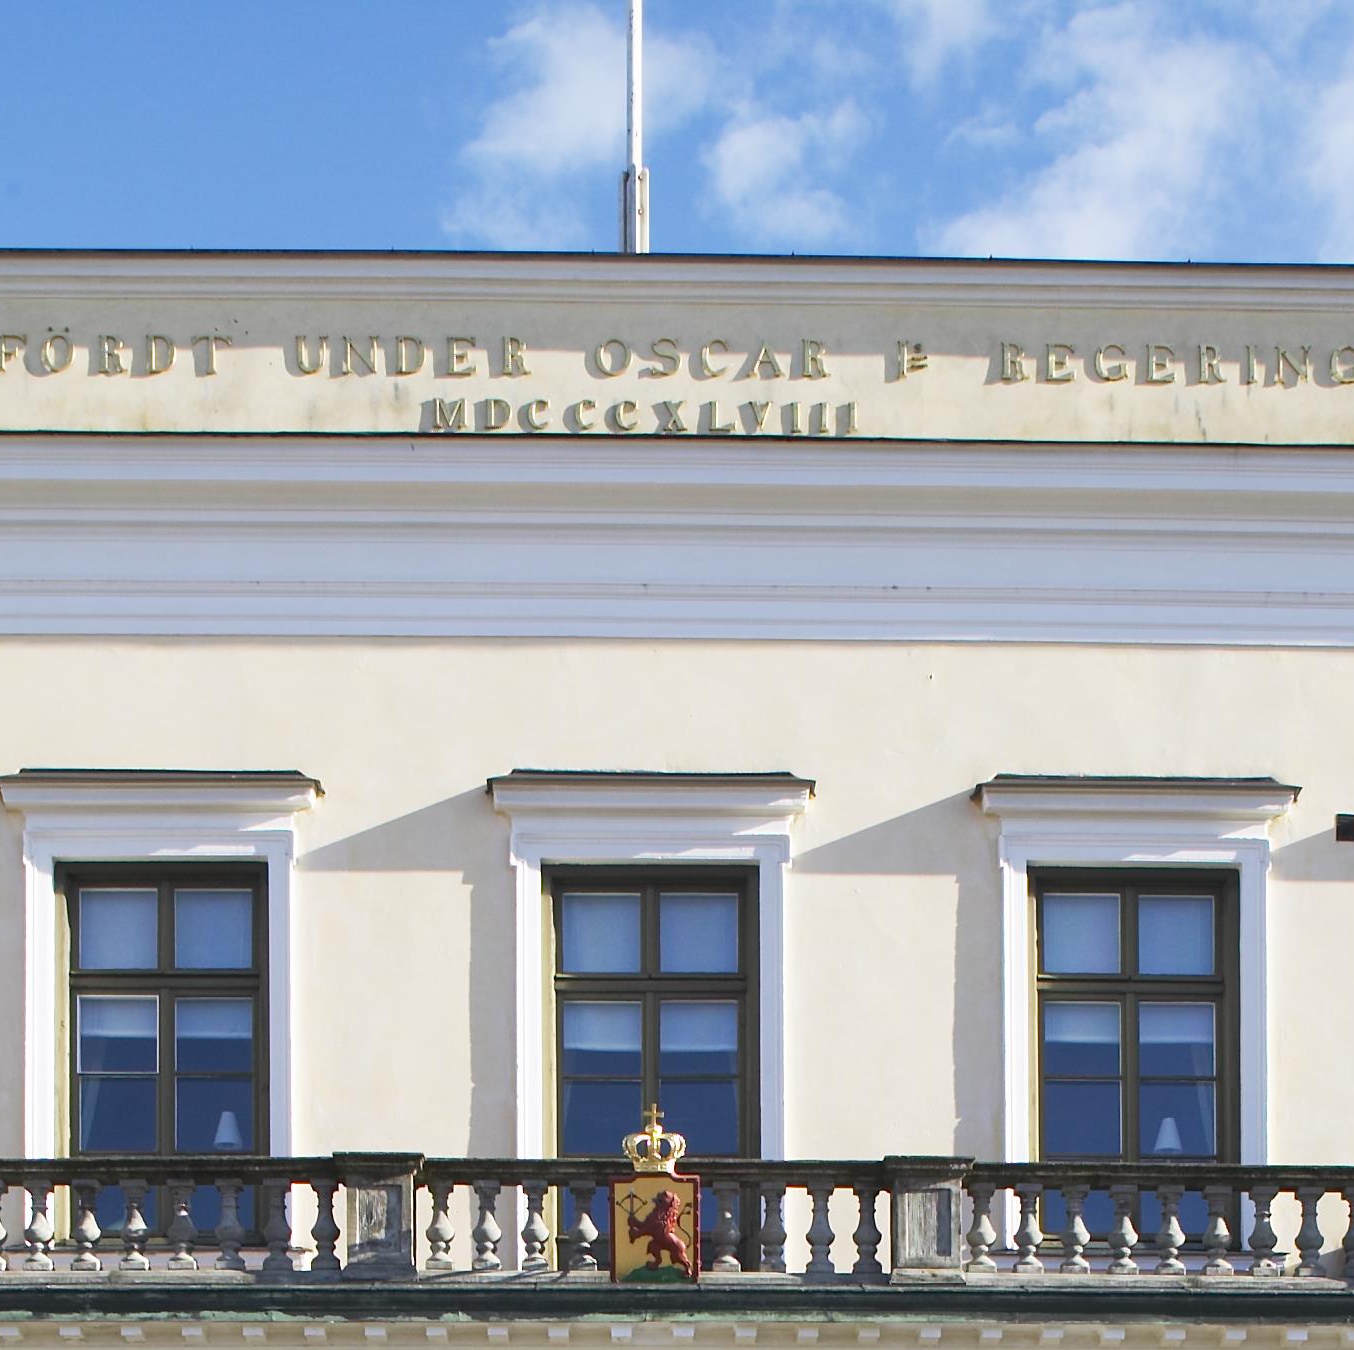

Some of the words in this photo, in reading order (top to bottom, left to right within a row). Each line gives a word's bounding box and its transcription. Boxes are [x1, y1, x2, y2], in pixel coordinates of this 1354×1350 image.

[294, 335, 533, 377] UNDER
[595, 337, 833, 379] OSCAR
[431, 397, 860, 434] MDCCCXLVIII
